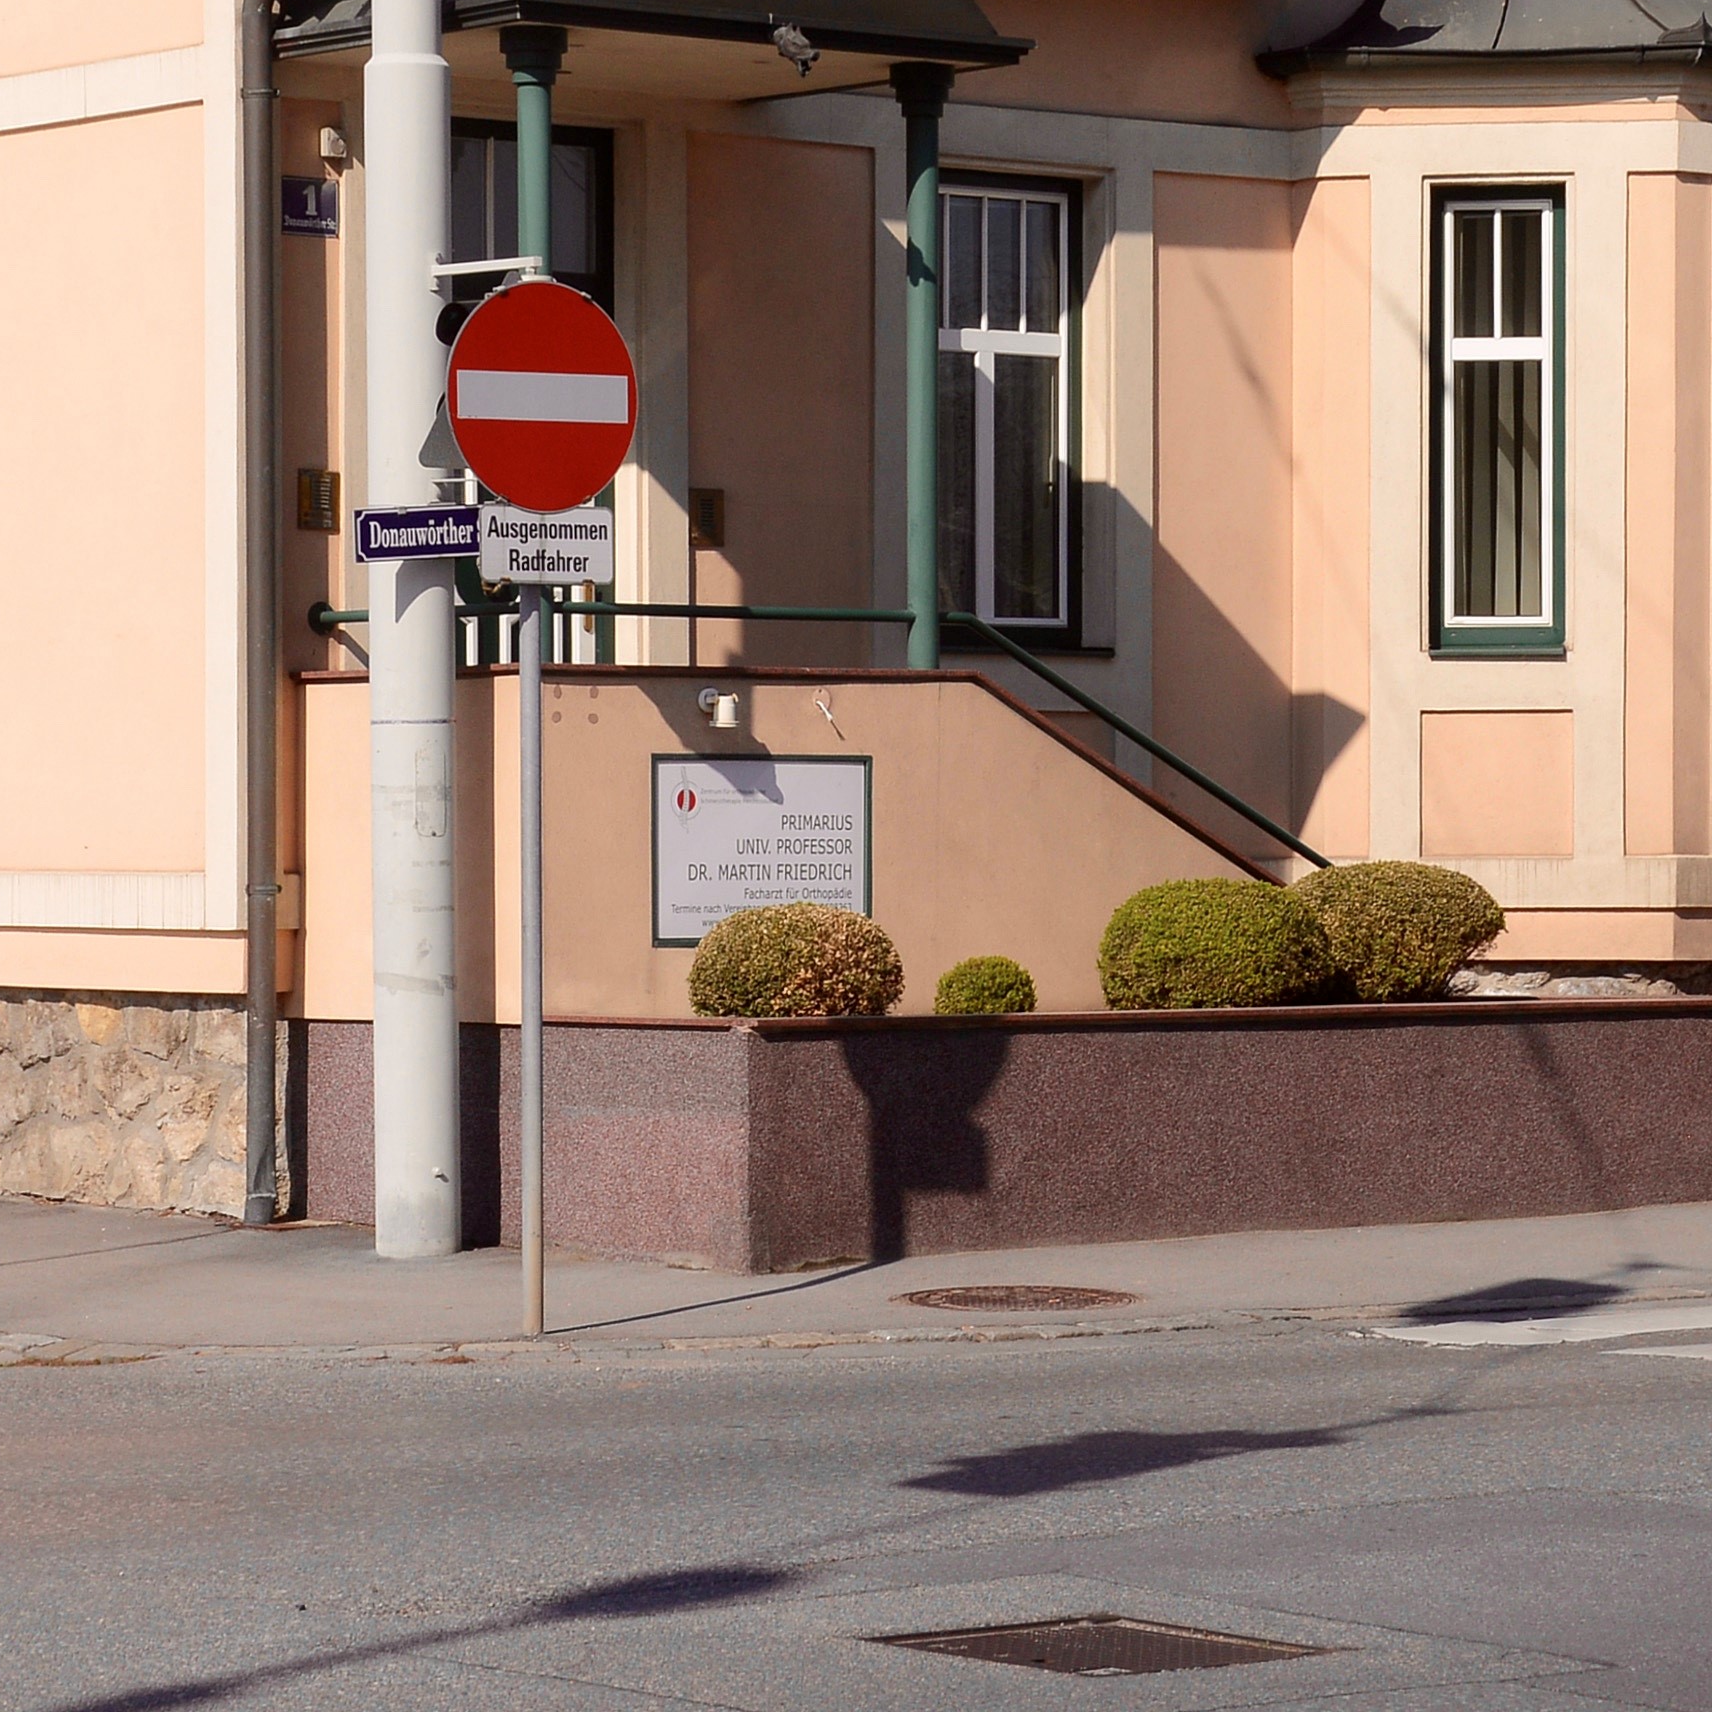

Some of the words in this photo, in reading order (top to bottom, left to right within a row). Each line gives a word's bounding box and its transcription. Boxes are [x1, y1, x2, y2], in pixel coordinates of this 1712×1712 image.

[302, 184, 318, 216] 1
[368, 517, 475, 549] Donauwörther
[487, 515, 609, 543] Ausgenommen
[508, 548, 590, 573] Radfahrer
[781, 814, 854, 831] PRIMARIUS
[736, 838, 772, 855] UNIV.
[776, 838, 854, 855] PROFESSOR
[688, 863, 713, 881] DR.
[718, 863, 772, 881] MARTIN
[776, 863, 853, 881] FRIEDRICH
[744, 887, 783, 900] Facharzt
[786, 887, 799, 900] für
[801, 887, 853, 902] Orthopädie
[671, 903, 702, 914] Termine
[703, 903, 722, 914] nach
